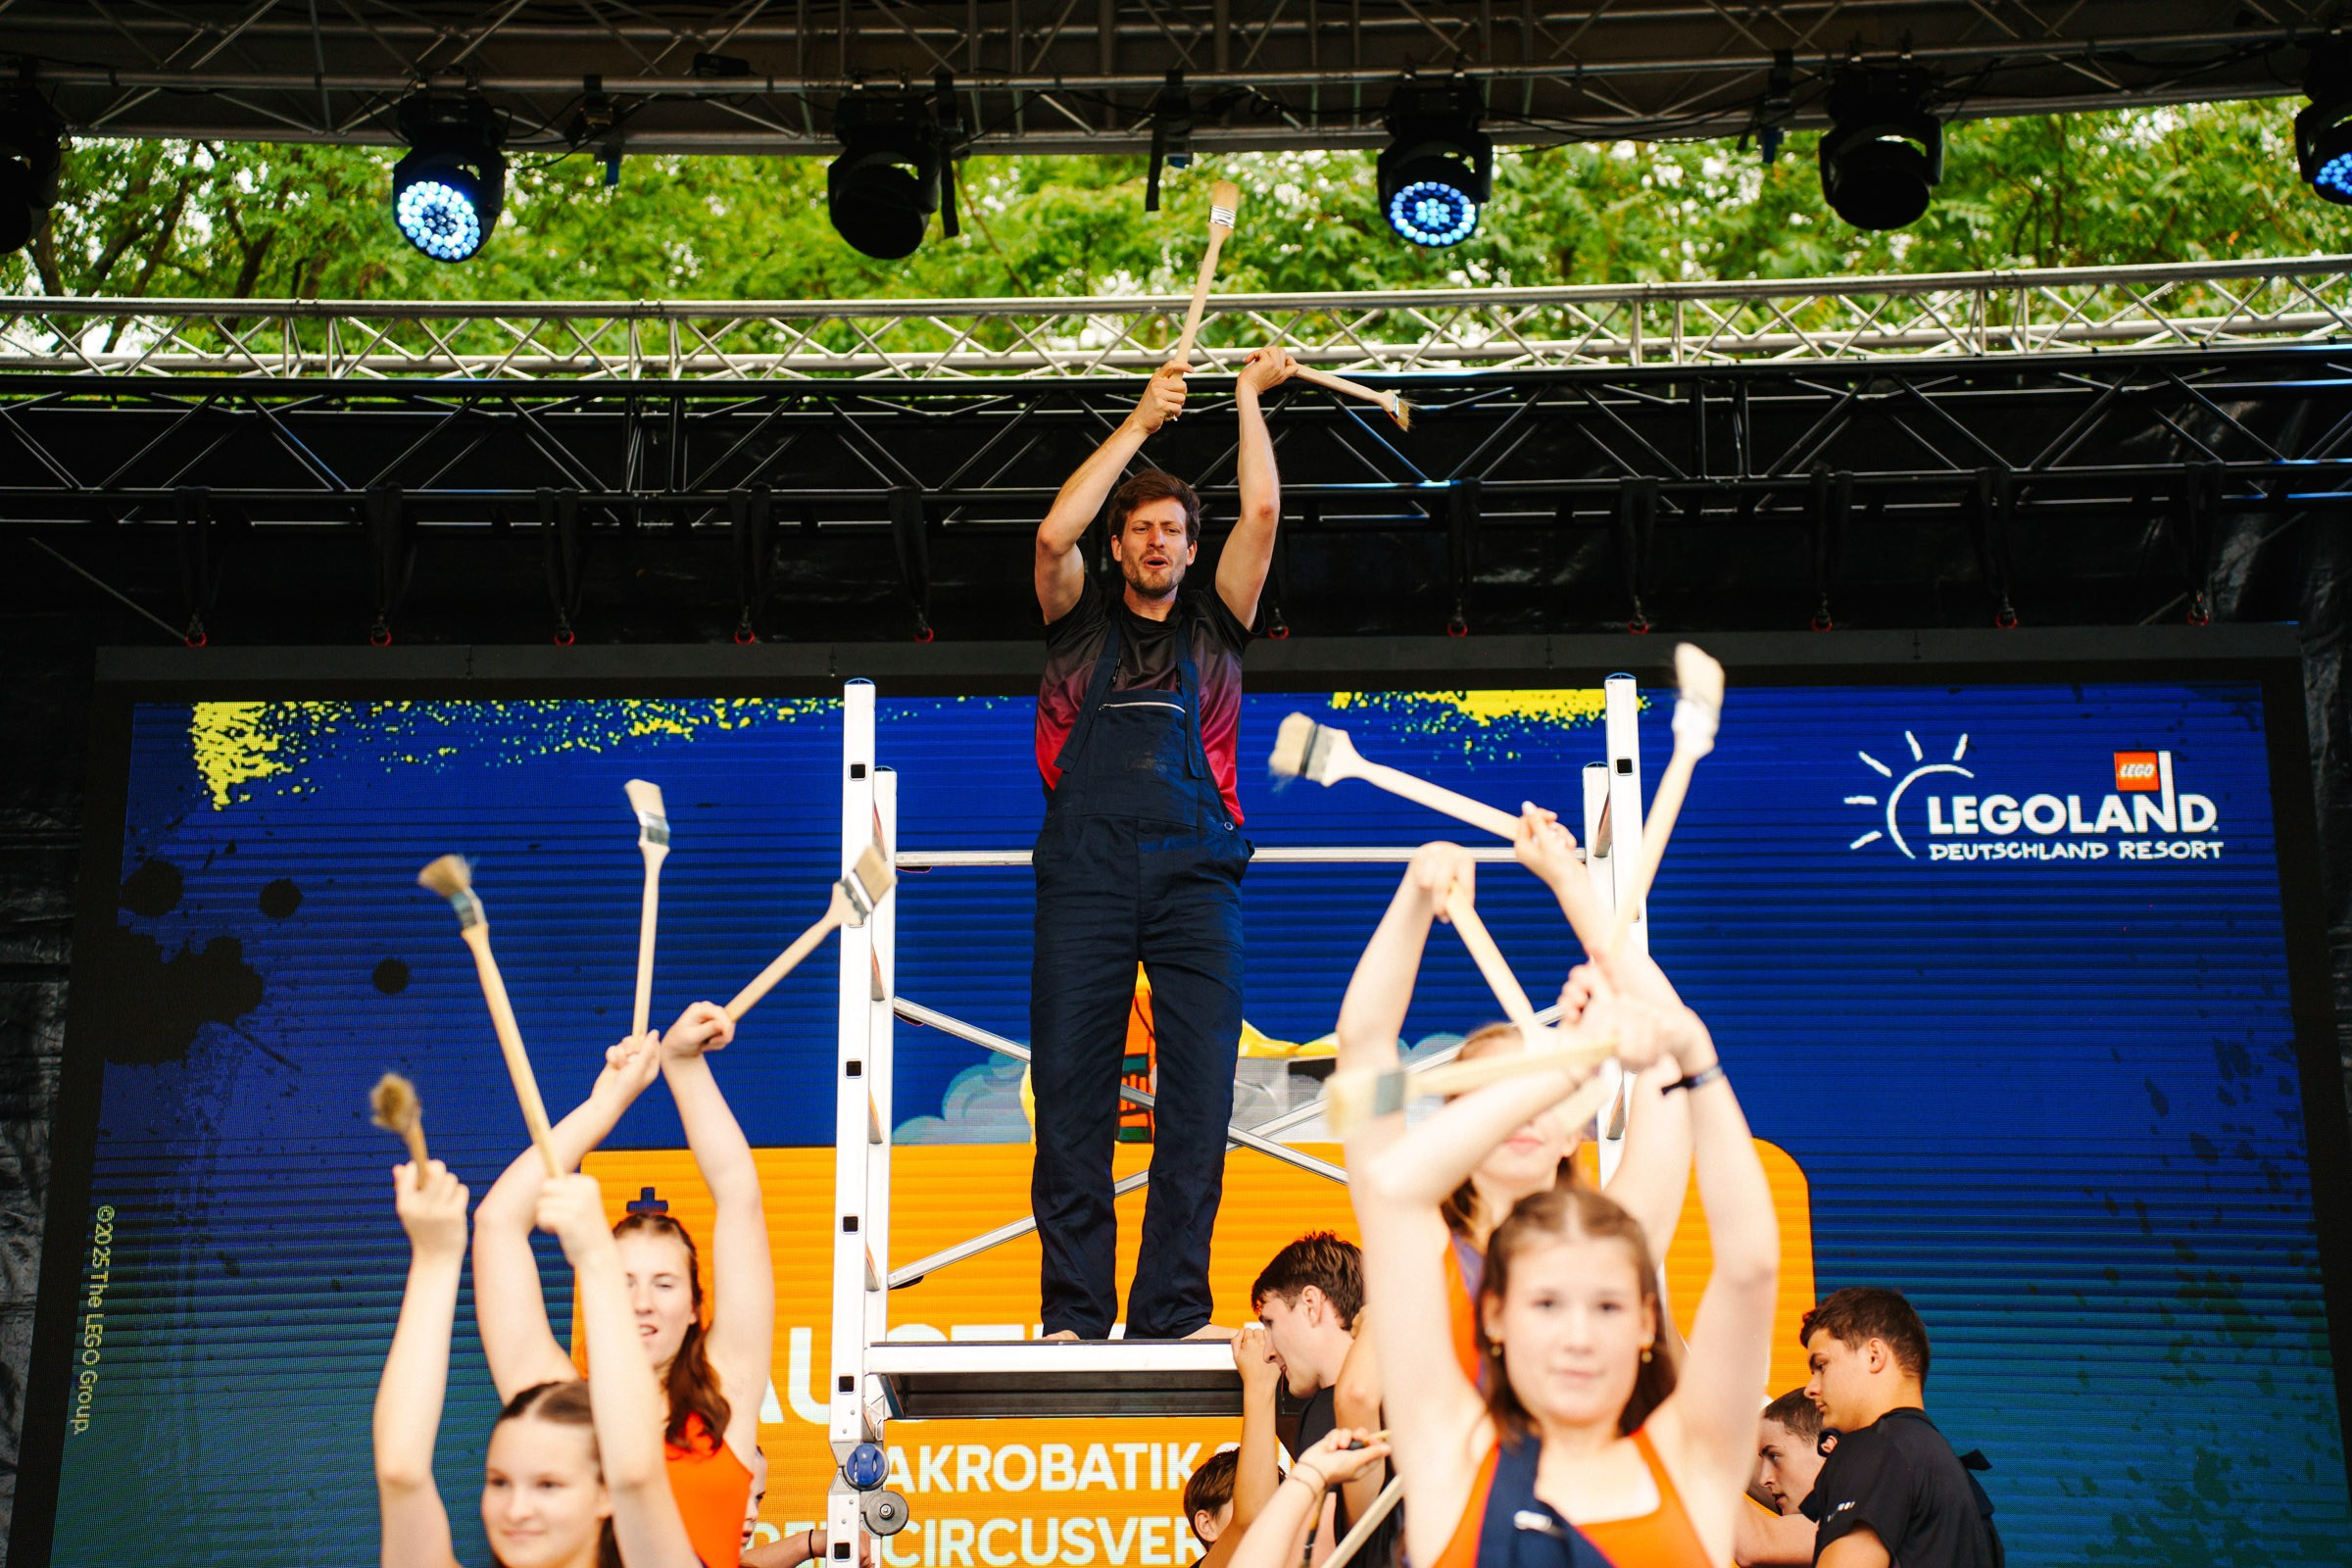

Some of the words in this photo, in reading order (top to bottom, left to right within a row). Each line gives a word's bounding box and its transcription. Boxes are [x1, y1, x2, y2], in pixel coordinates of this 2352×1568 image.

[2120, 763, 2154, 778] LEGO
[1928, 842, 2109, 860] DEUTSCHLAND
[2119, 841, 2224, 859] RESORT
[89, 1271, 109, 1307] The
[82, 1314, 104, 1364] LEGO
[71, 1370, 98, 1434] Group
[884, 1444, 1201, 1493] AKROBATIK
